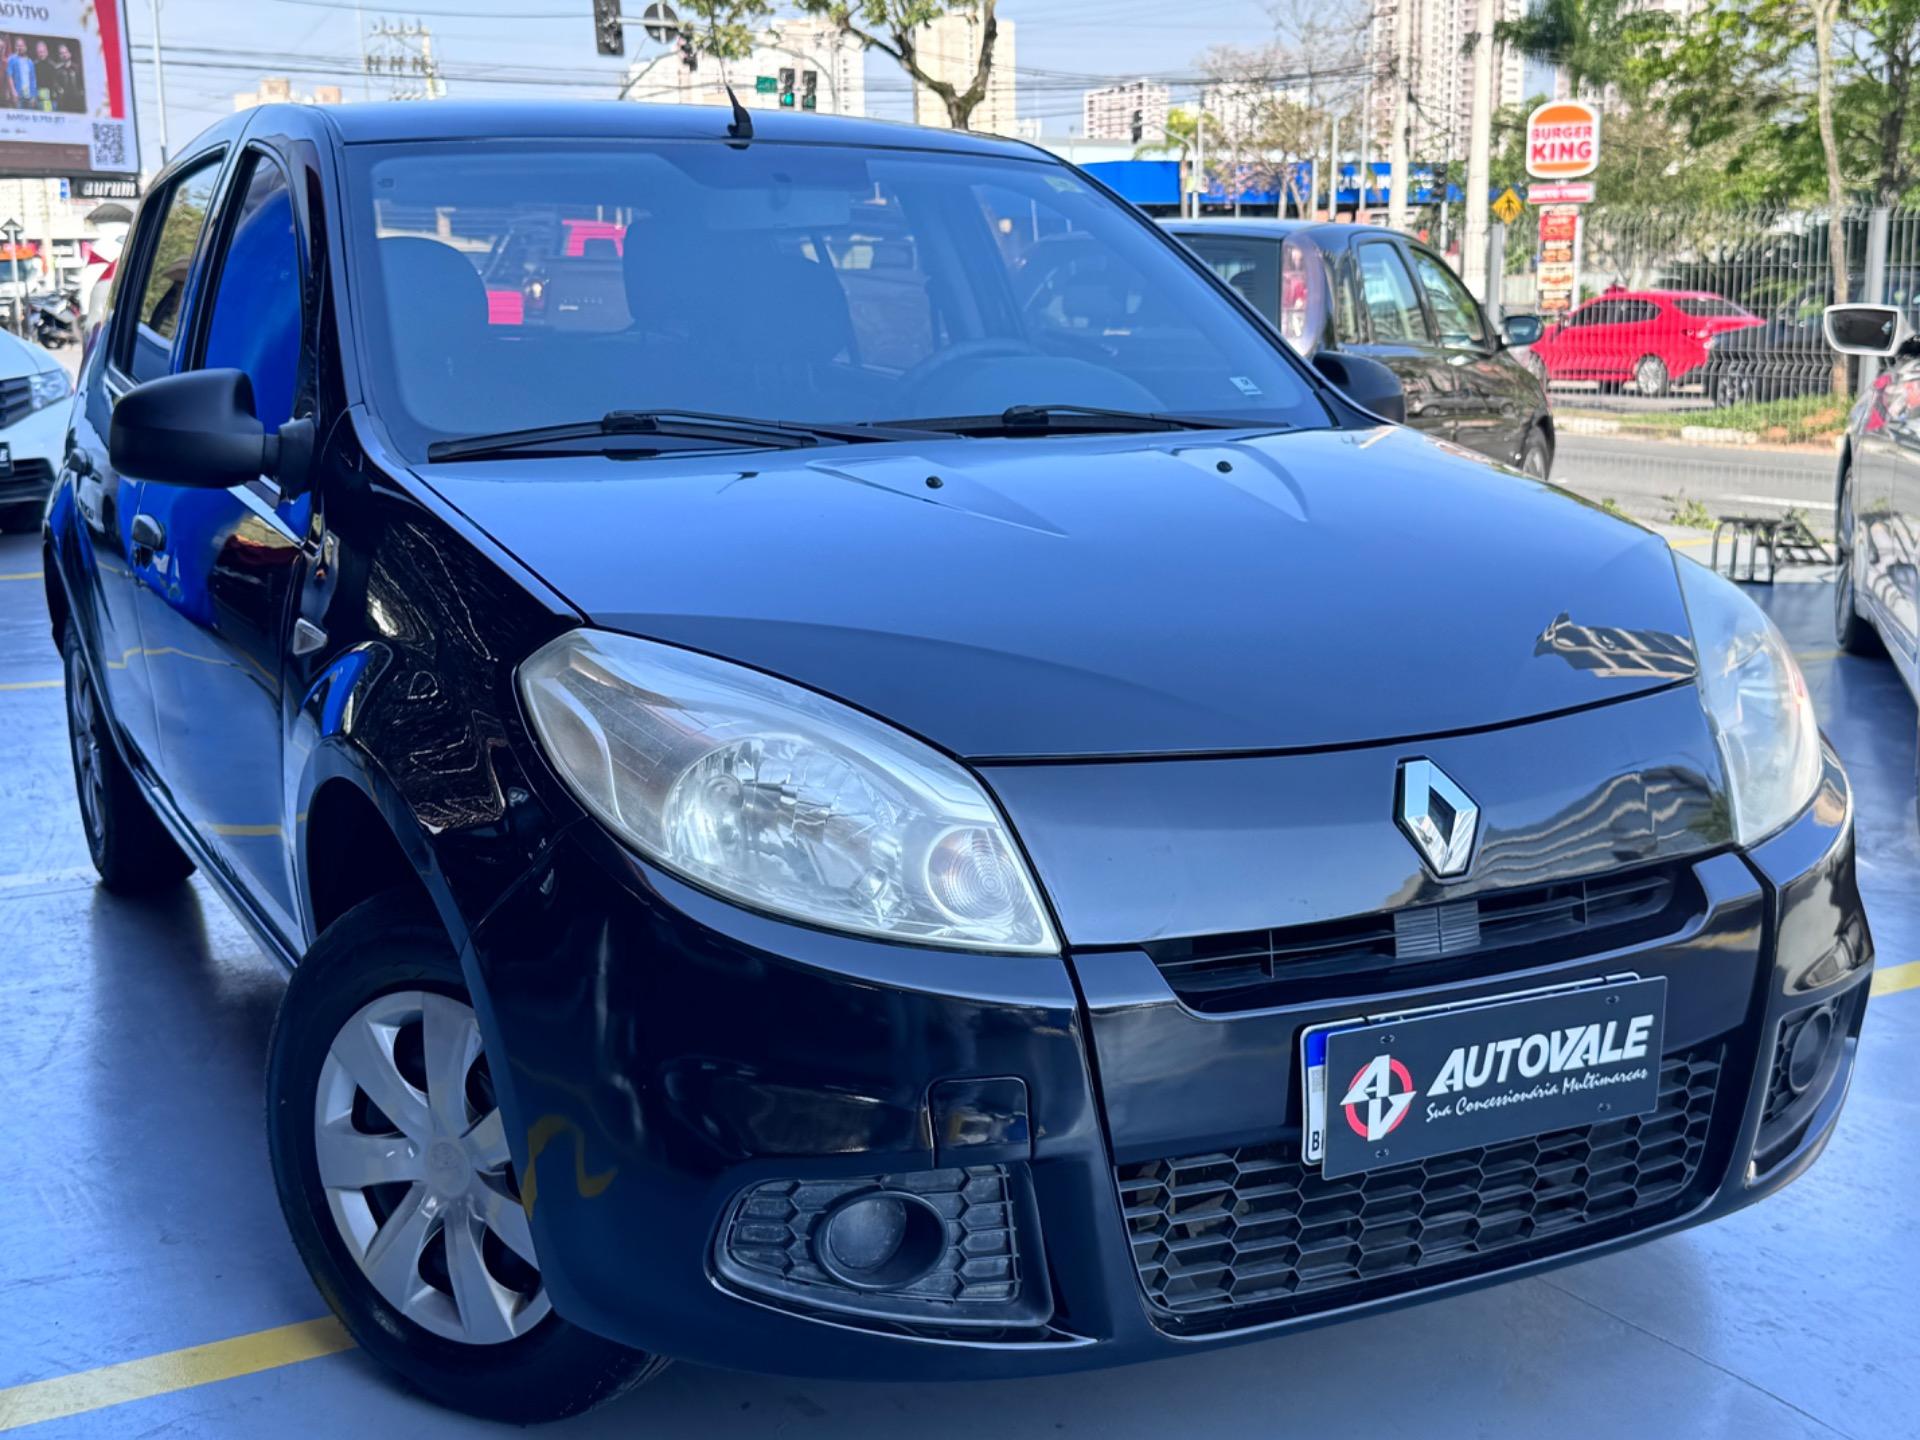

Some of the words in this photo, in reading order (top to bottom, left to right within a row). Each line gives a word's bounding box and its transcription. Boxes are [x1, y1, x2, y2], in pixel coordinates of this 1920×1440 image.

[16, 4, 49, 21] VIVO
[1531, 125, 1592, 141] BURGER
[1531, 141, 1592, 162] KING
[83, 181, 136, 197] aurum
[1426, 1014, 1654, 1097] AUTOVALE
[1425, 1101, 1452, 1123] Sua
[1456, 1082, 1559, 1116] Concessionária
[1561, 1067, 1648, 1095] Multimarcas
